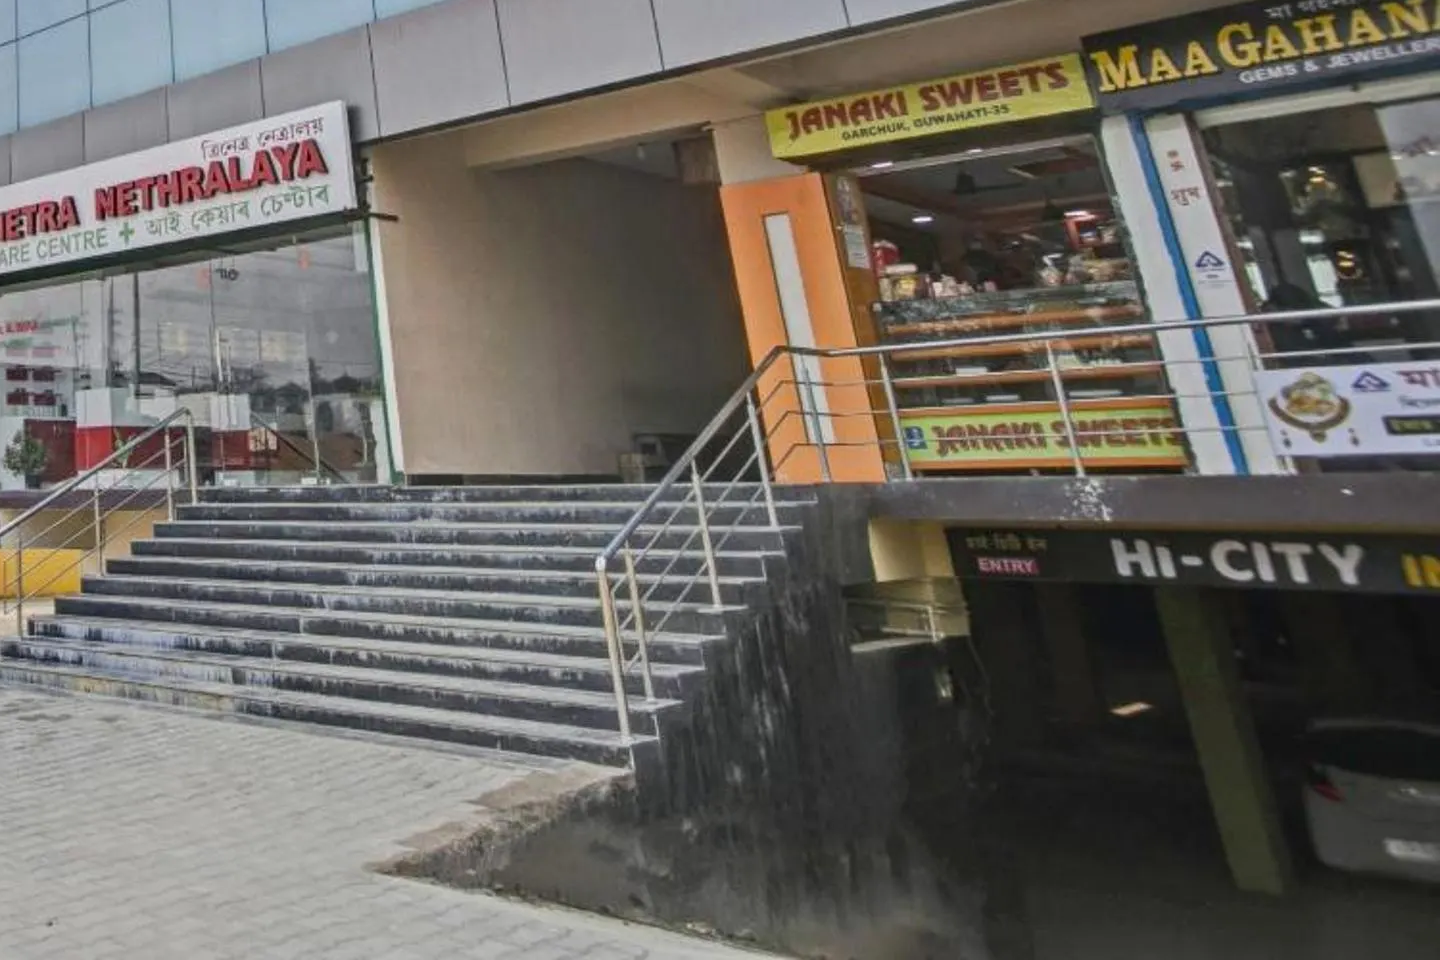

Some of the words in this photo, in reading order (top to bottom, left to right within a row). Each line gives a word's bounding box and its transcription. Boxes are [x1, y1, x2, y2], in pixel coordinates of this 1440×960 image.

[1237, 62, 1298, 84] GEMS
[1303, 60, 1319, 73] &
[783, 90, 909, 141] JANAKI
[919, 61, 1069, 112] SWEETS
[94, 138, 329, 222] NETHRALAYA
[36, 228, 108, 259] CENTRE
[931, 421, 1048, 457] JANAKI
[1049, 416, 1185, 449] SWEETS
[977, 557, 1036, 574] ENTRY
